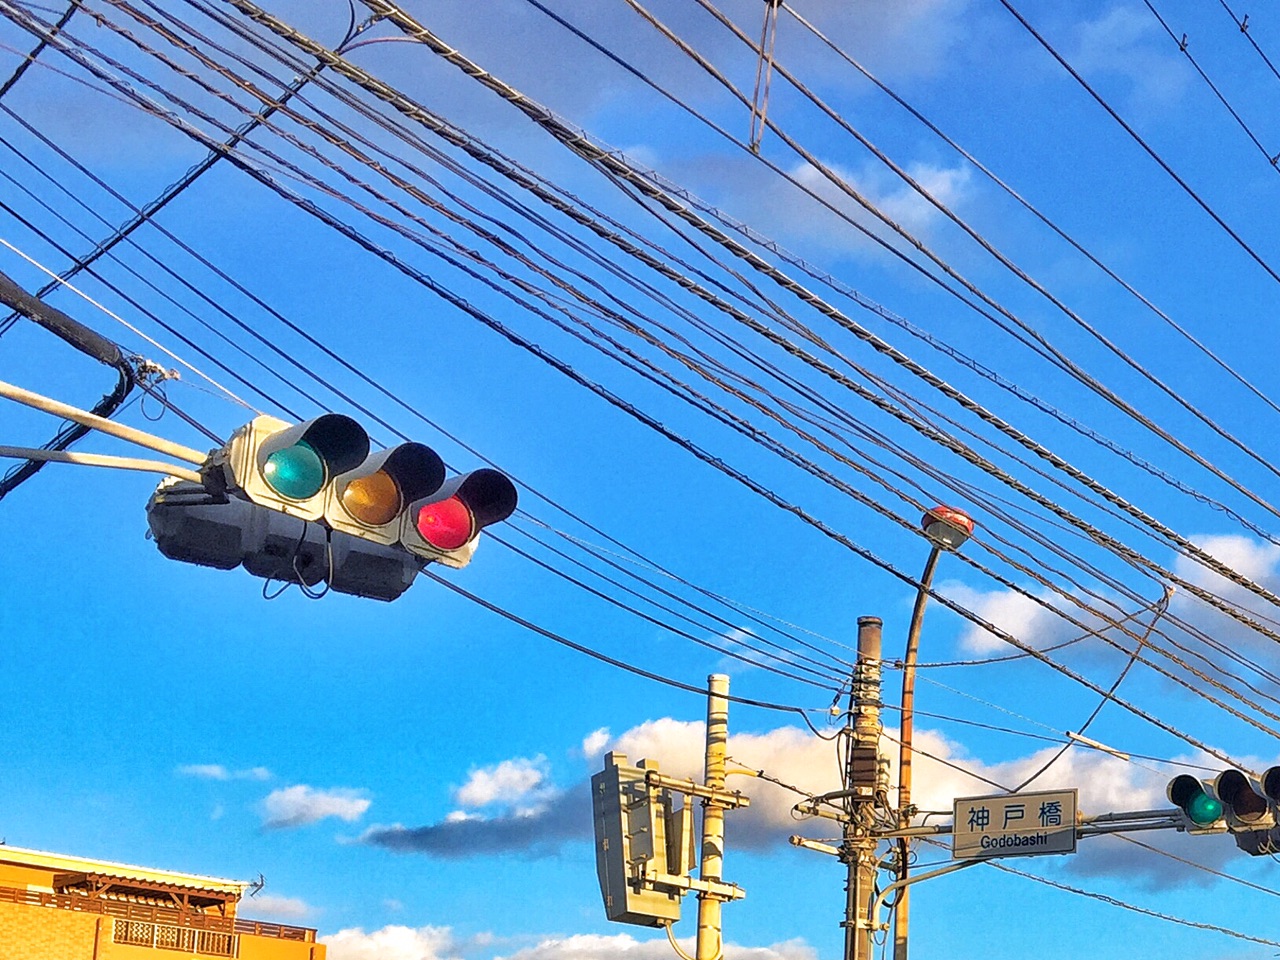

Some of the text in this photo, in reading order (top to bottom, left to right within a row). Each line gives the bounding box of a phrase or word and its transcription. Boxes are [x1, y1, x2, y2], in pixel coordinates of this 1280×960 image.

[967, 801, 1062, 832] 神戸橋
[980, 832, 1048, 849] Godobashi
